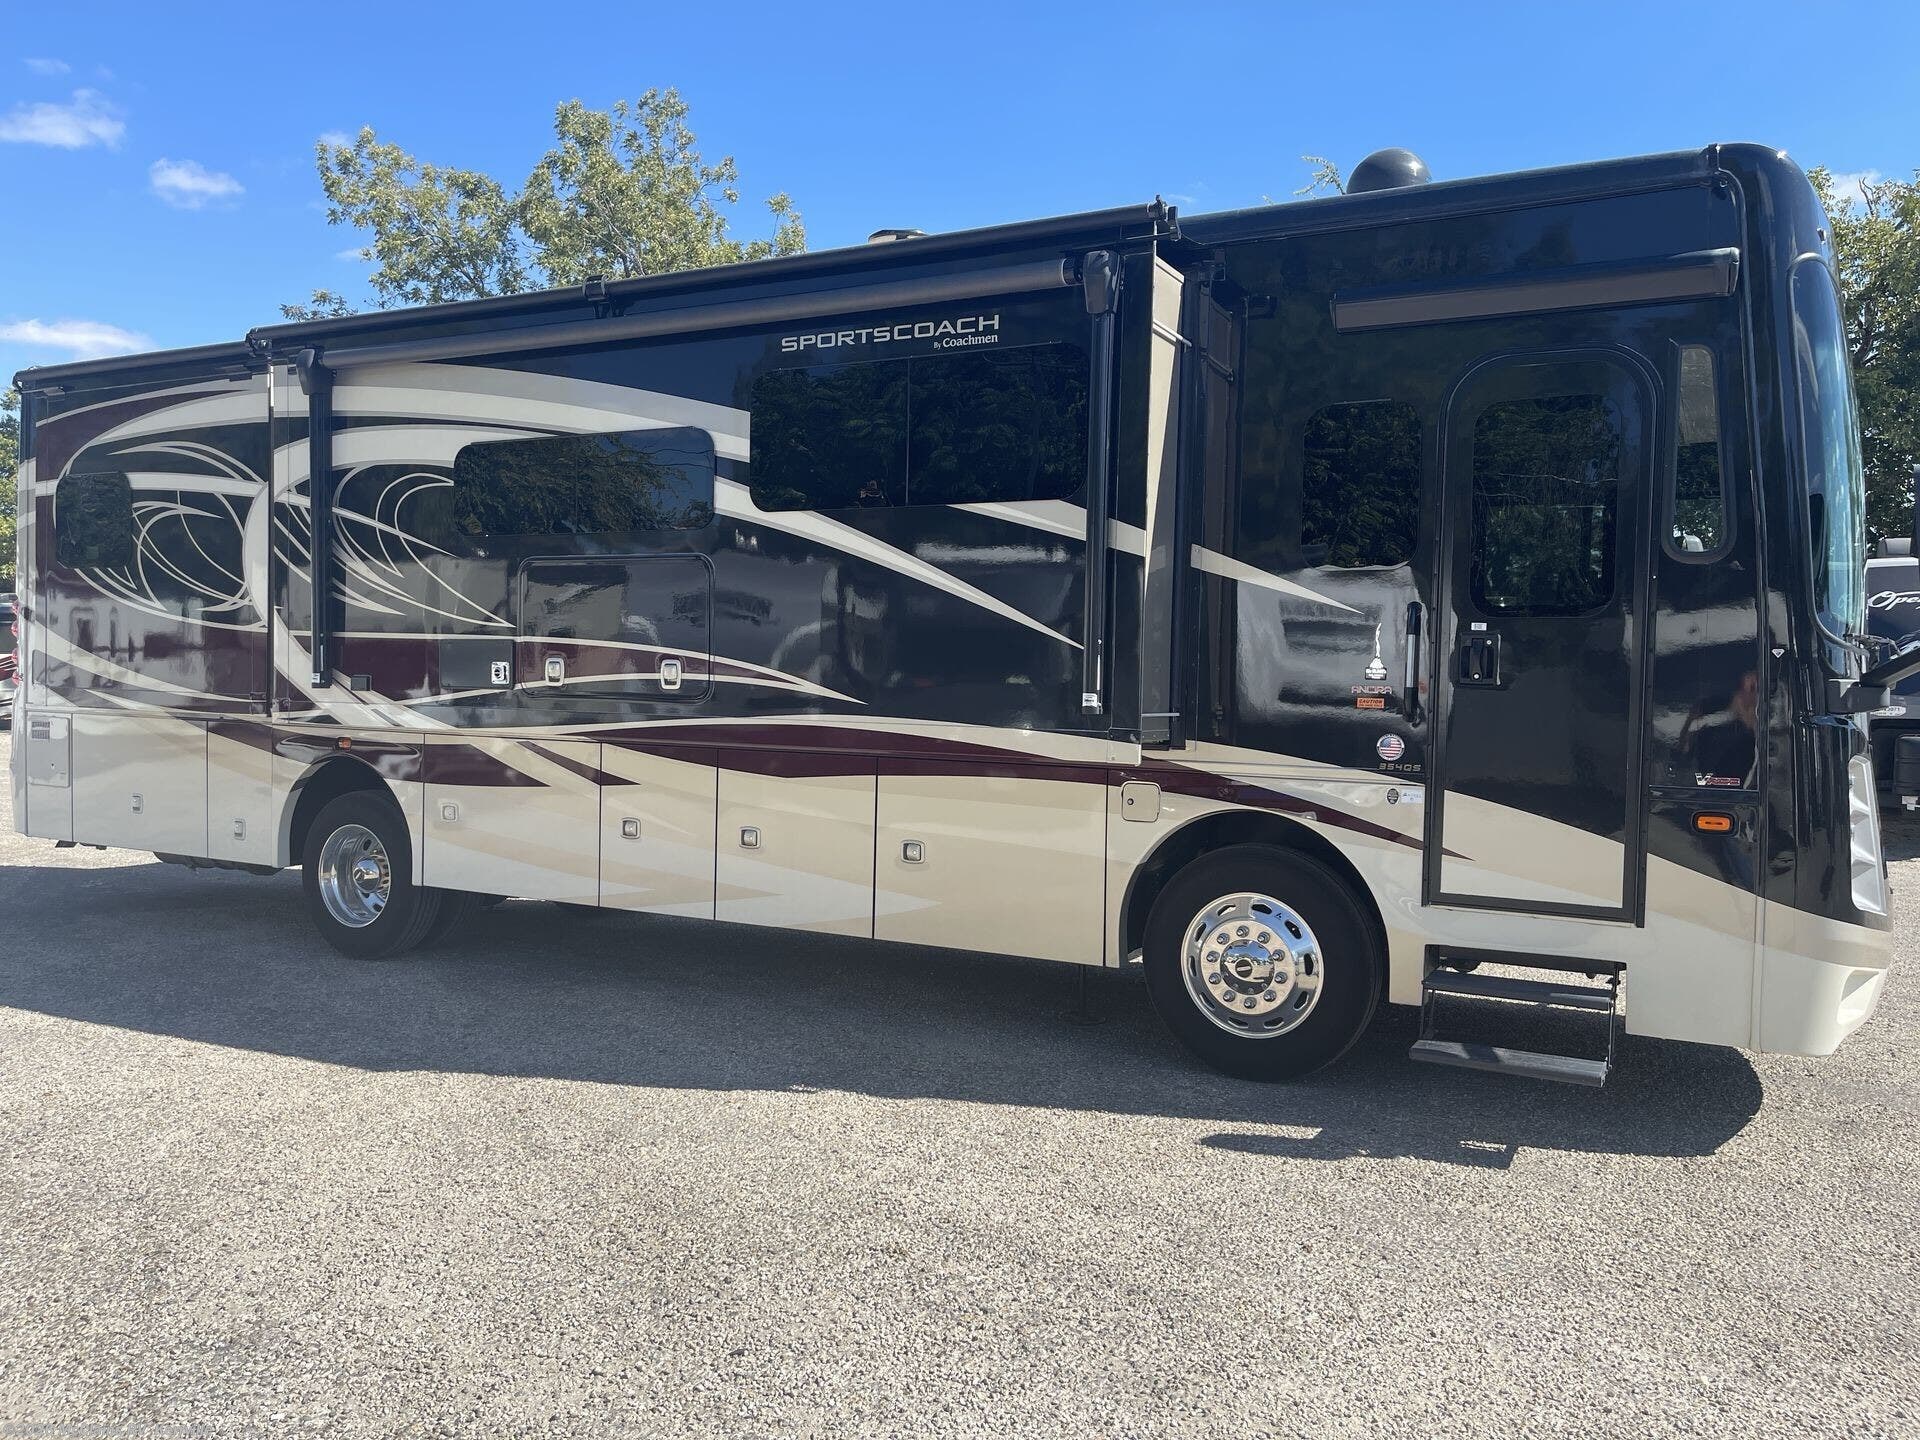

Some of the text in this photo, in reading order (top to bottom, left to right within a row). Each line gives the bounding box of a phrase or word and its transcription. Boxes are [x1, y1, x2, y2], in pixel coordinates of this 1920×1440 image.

[781, 315, 999, 352] SPORTSCOACH
[933, 334, 998, 350] By Coachmen
